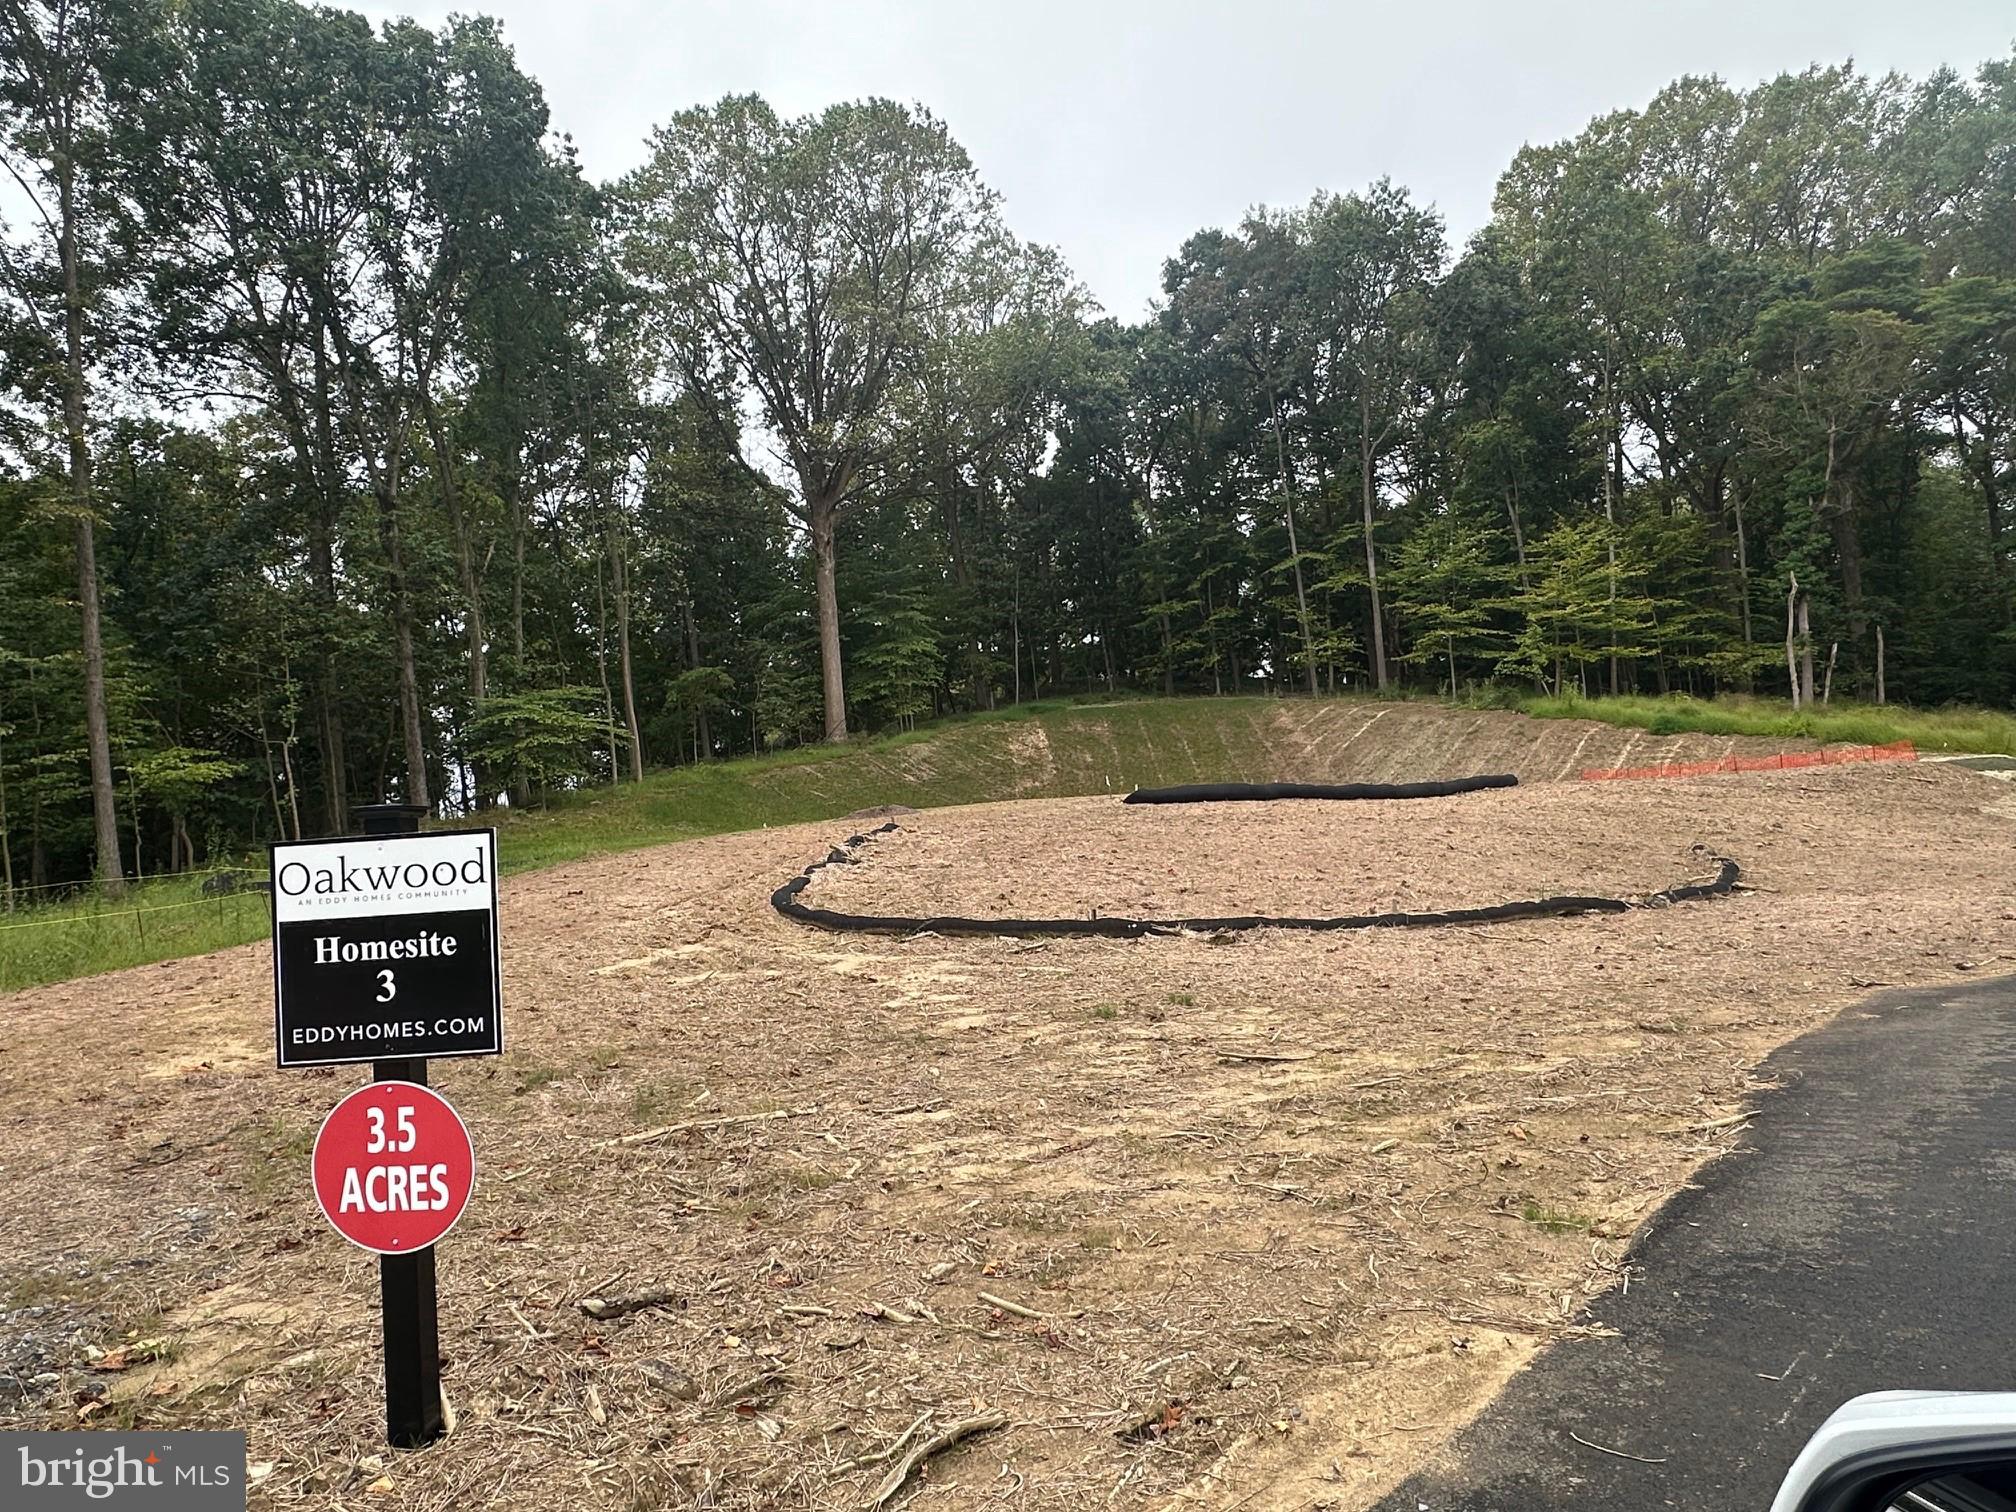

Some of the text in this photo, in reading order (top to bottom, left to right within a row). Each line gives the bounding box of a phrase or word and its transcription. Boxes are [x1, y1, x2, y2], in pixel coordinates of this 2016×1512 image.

[279, 847, 487, 896] Oakwood
[298, 889, 469, 906] AN EDDY HOMES COMMUNITY
[313, 931, 458, 964] Homesite
[376, 970, 396, 1002] 3
[292, 1017, 485, 1044] EDDYHOMES.COM
[366, 1106, 416, 1153] 3.5
[339, 1163, 449, 1213] ACRES
